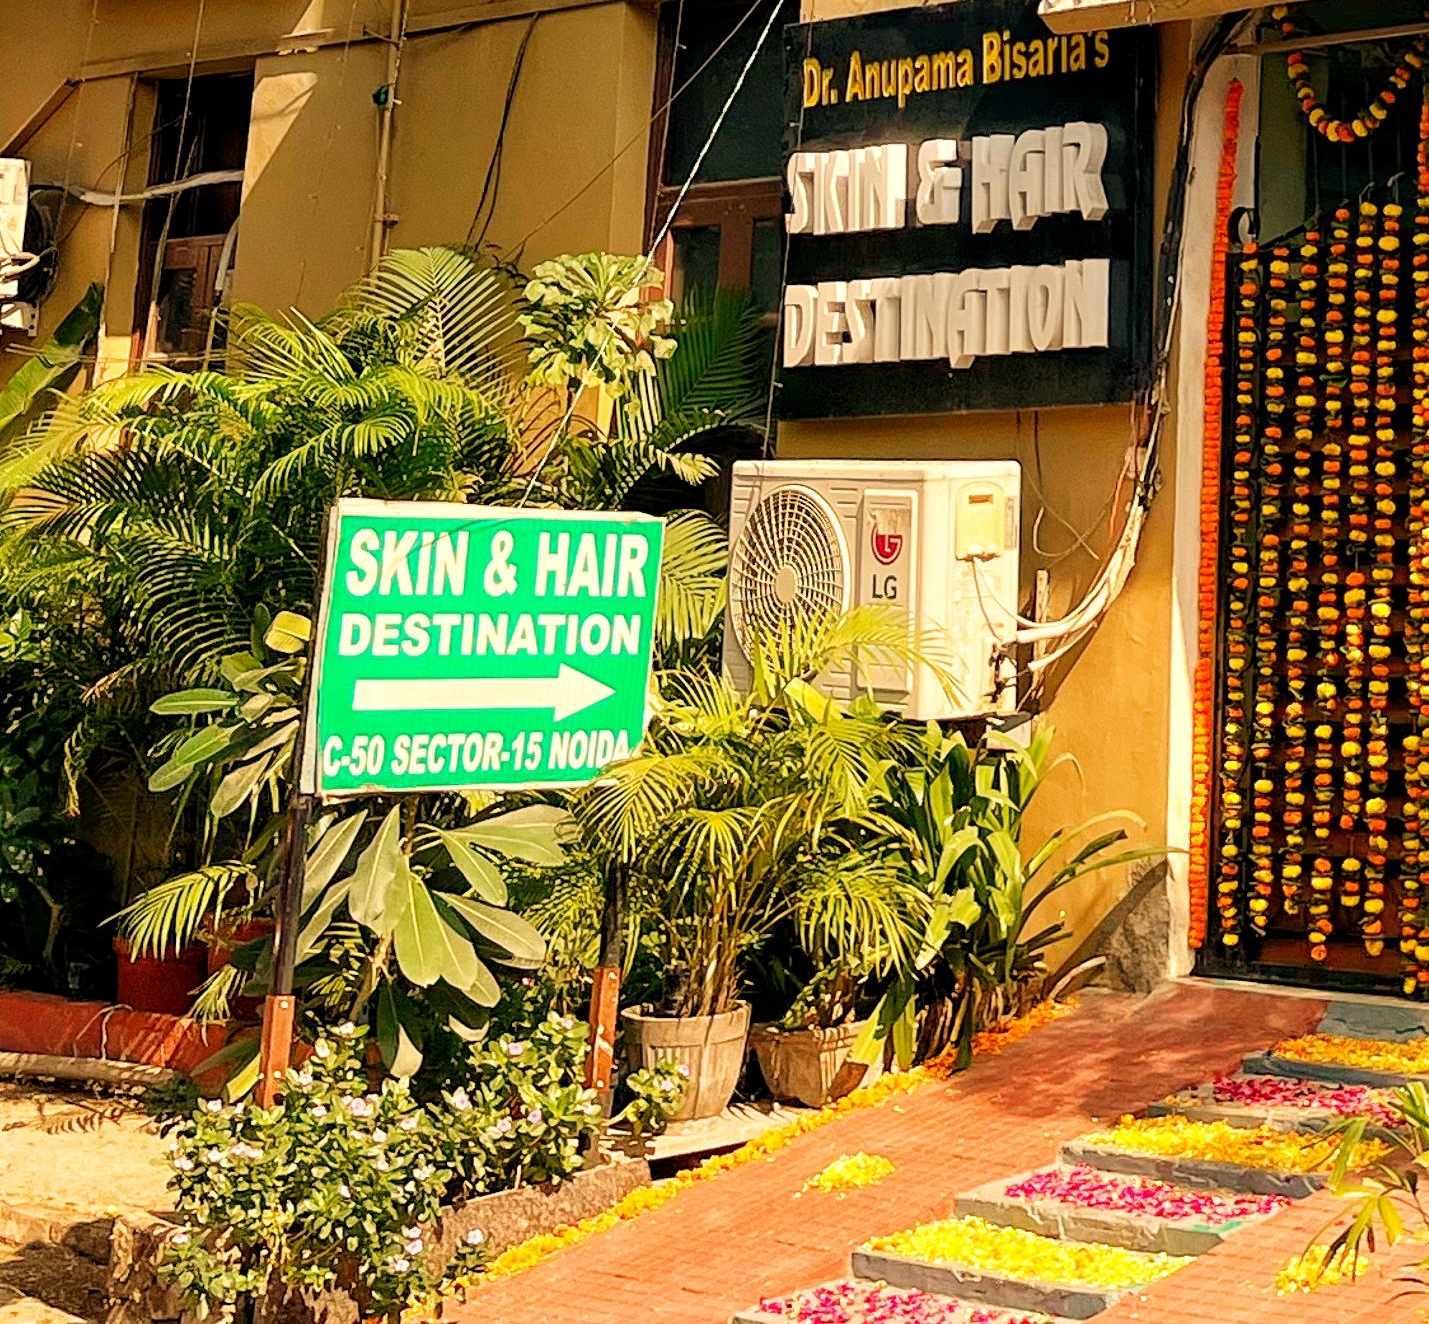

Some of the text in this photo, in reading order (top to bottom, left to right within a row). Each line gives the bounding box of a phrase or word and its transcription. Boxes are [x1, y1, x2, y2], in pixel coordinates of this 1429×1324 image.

[803, 57, 838, 108] Dr.
[845, 48, 974, 109] Anupama
[784, 120, 1109, 236] SKIN & HAIR
[783, 258, 1111, 369] DESTINATION
[345, 528, 650, 598] SKIN & HAIR
[872, 574, 898, 599] LG
[338, 613, 642, 656] DESTINATION
[324, 730, 630, 777] C-50 SECTOR-15 NOIDA
